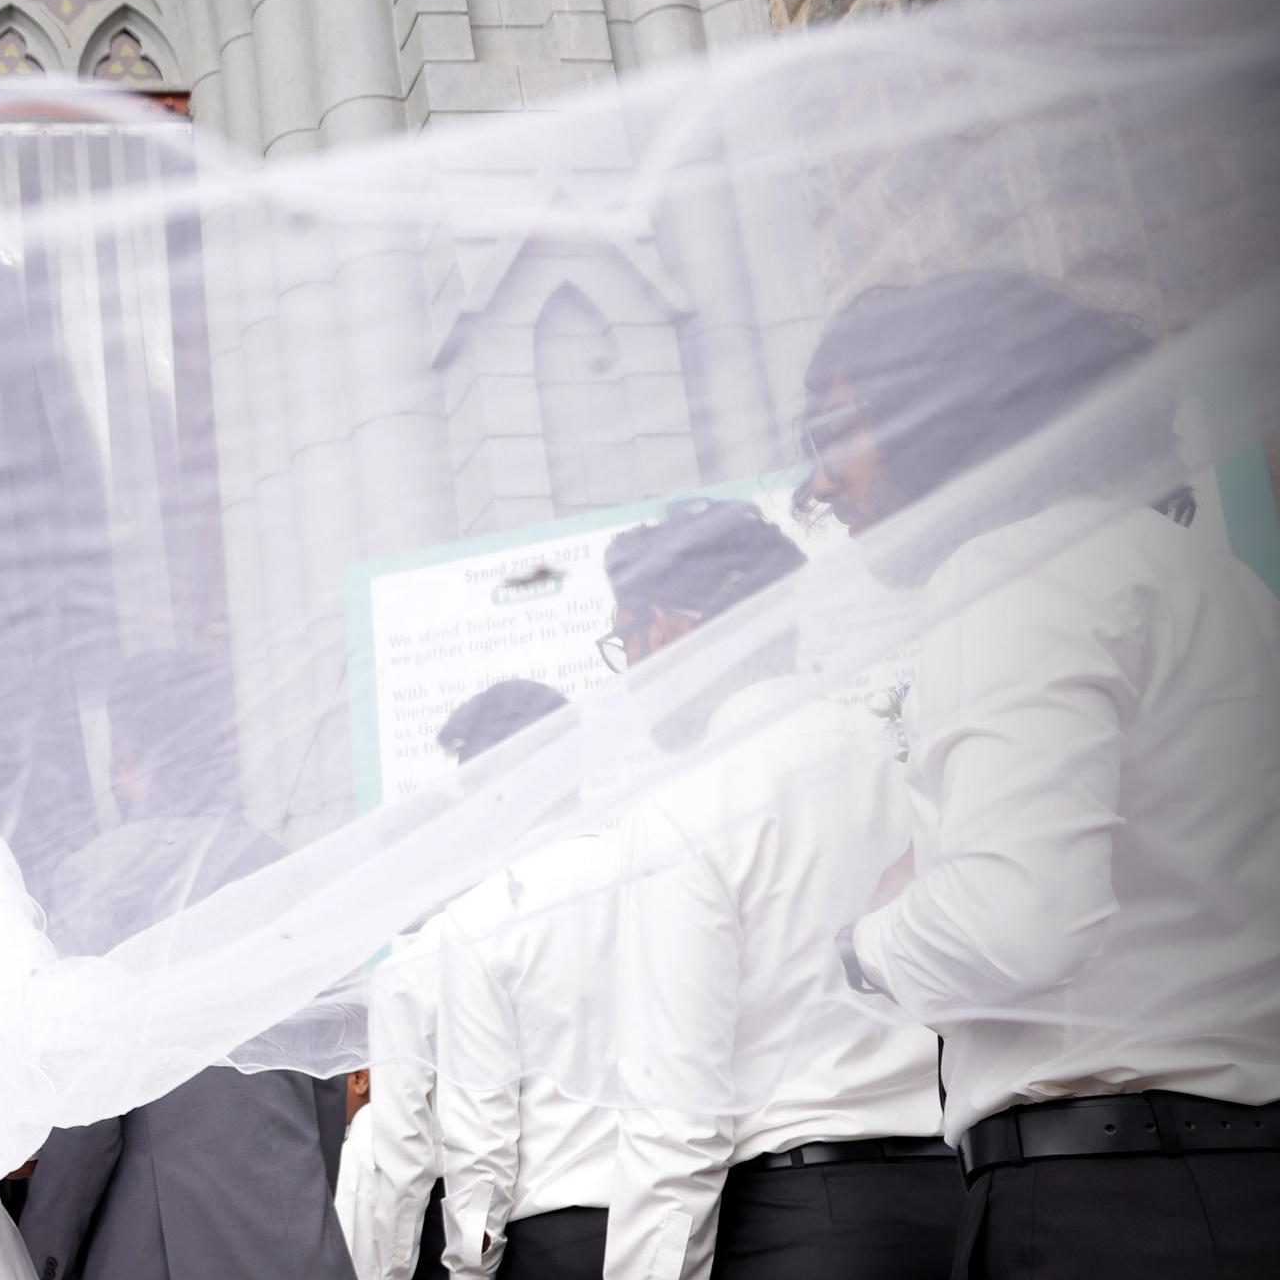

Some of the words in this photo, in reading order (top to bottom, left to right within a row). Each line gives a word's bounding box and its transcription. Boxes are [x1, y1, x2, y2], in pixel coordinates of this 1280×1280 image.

[465, 562, 507, 584] Synod
[511, 545, 590, 573] 2021-2023
[389, 633, 411, 649] We
[418, 624, 460, 643] stand
[467, 614, 517, 635] before
[524, 607, 559, 625] You,
[566, 598, 605, 618] Holy
[389, 653, 411, 667] we
[414, 643, 464, 667] gather
[468, 630, 539, 653] together
[540, 625, 556, 642] in
[560, 618, 600, 638] Your
[391, 685, 428, 703] With
[439, 679, 466, 696] You
[530, 665, 547, 681] to
[557, 656, 604, 678] guide
[394, 726, 412, 740] us
[395, 744, 420, 759] are
